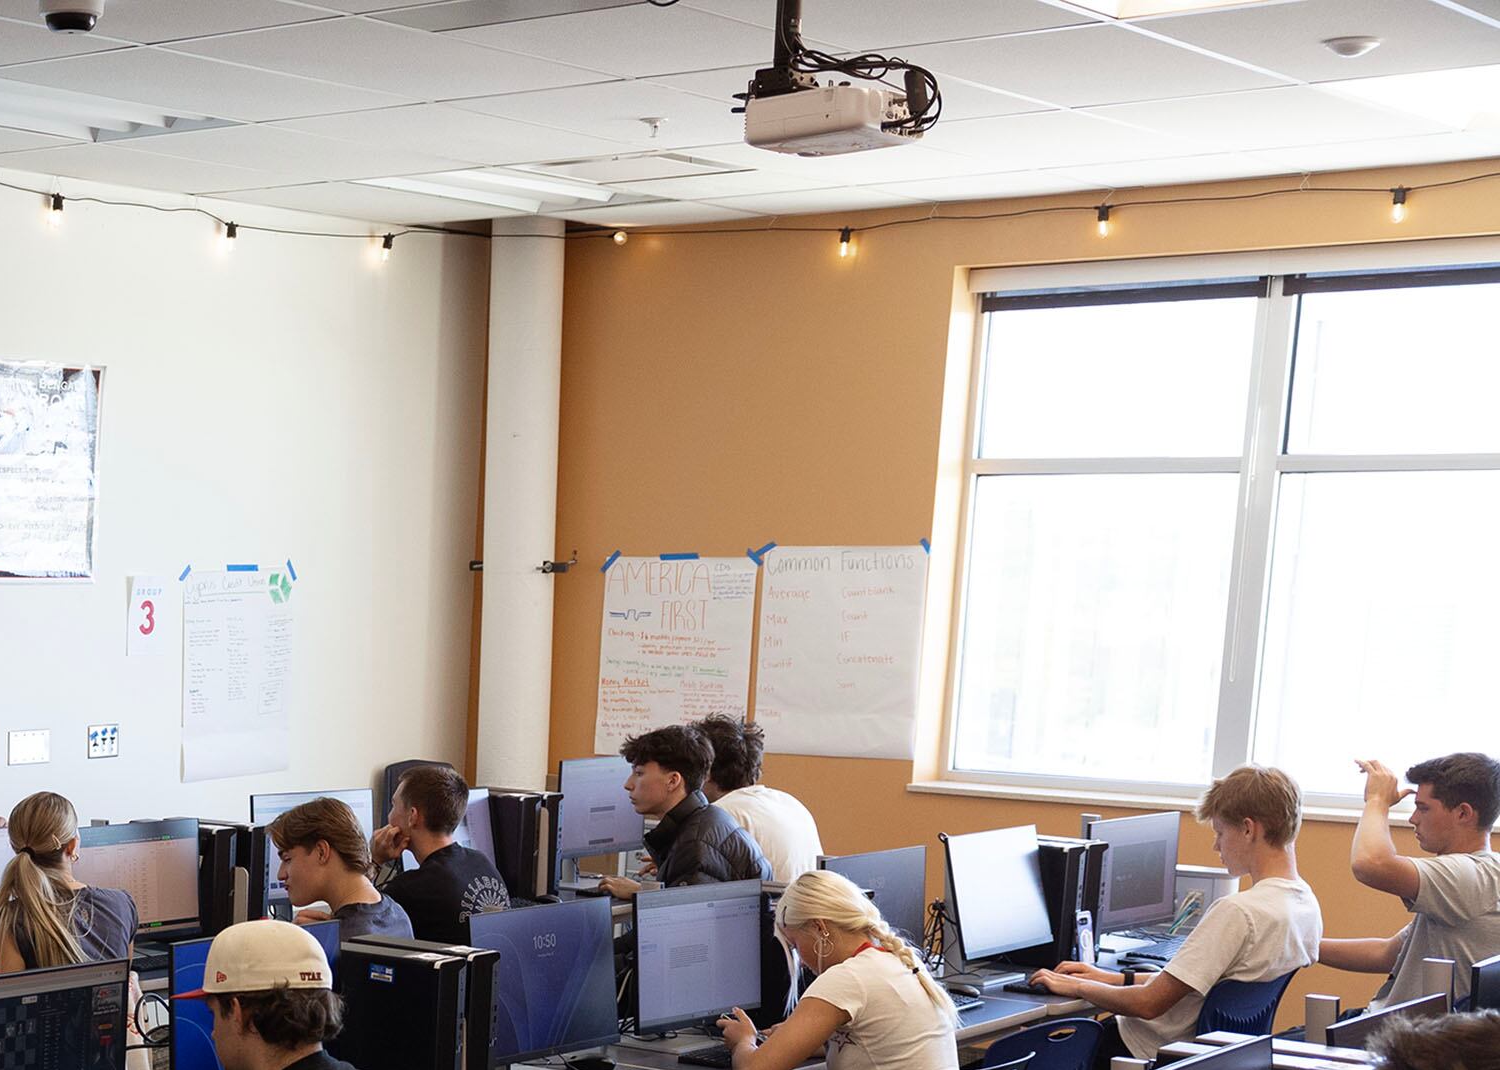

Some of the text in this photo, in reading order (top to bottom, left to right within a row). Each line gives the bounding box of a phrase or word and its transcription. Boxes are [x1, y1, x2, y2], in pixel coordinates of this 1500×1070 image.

[766, 550, 915, 576] Common Functions
[608, 561, 711, 596] AMERICA
[768, 586, 811, 601] Average
[139, 600, 155, 635] 3
[661, 600, 708, 631] FIRST
[765, 614, 789, 626] Max
[763, 635, 783, 648] Min
[458, 875, 510, 923] BILLABON
[533, 933, 557, 950] 10:50
[299, 971, 323, 981] UTAH
